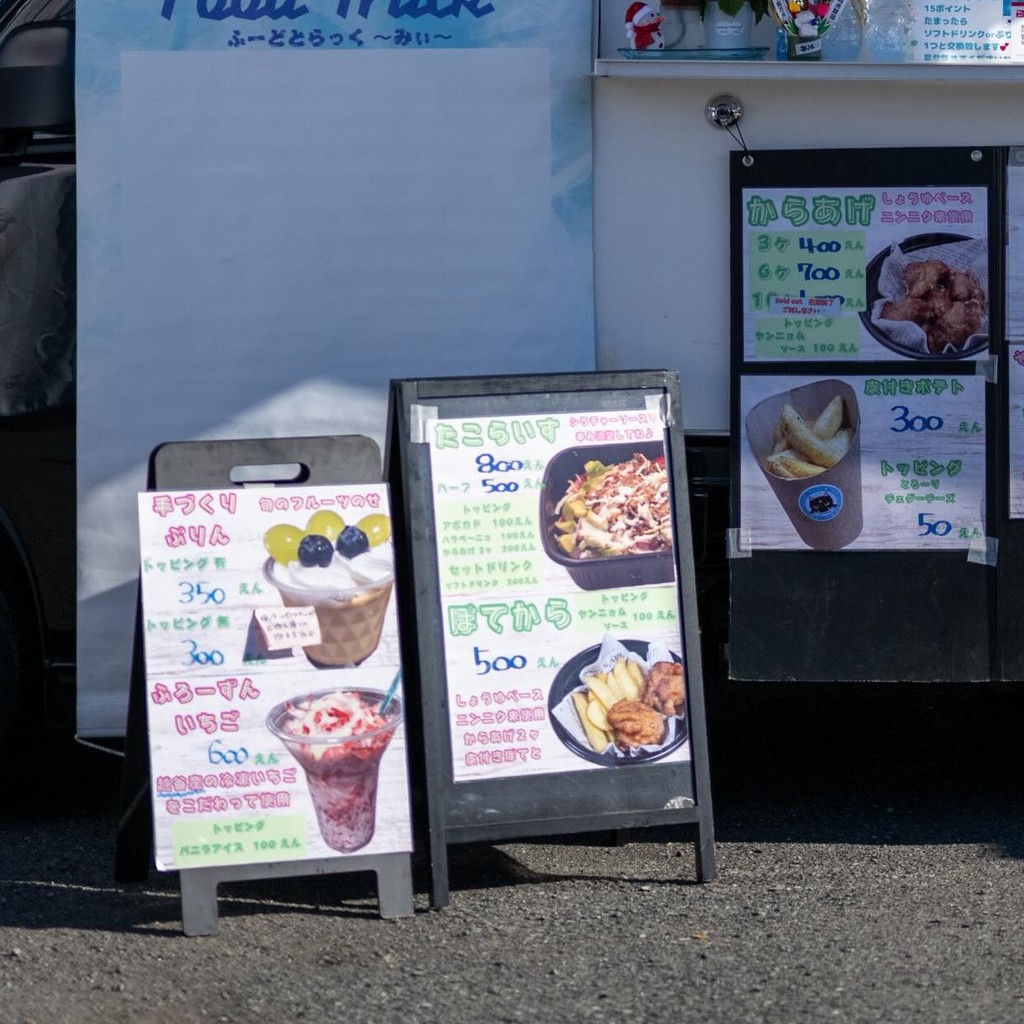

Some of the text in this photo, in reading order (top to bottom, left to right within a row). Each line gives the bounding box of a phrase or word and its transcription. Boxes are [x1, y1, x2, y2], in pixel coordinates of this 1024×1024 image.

[924, 4, 971, 13] 15ポイント
[924, 17, 968, 26] たまったら
[882, 192, 973, 205] しょうゆベース
[747, 194, 876, 226] からあげ
[881, 210, 973, 224] ニンニク未使用
[799, 237, 841, 253] 400
[798, 263, 840, 281] 700
[756, 331, 805, 341] ヤンニョム
[780, 344, 806, 353] ソース
[864, 379, 964, 396] 皮付きポテト
[890, 406, 982, 432] 300 えん
[434, 418, 560, 449] たこらいす
[475, 453, 524, 474] 800
[880, 460, 962, 477] トッピング
[438, 479, 519, 493] ハーフ 500
[153, 493, 237, 516] 手づくり
[259, 492, 380, 512] 旬のフルーツのせ
[443, 519, 481, 529] アボカド
[918, 513, 952, 536] 50
[165, 525, 230, 548] ぷりん
[449, 561, 532, 576] セットドリンク
[179, 582, 225, 604] 350
[445, 579, 498, 589] ソフトドリンク
[448, 598, 571, 636] ぽてから
[578, 609, 626, 621] ヤンニョム
[604, 621, 628, 630] ソース
[181, 640, 224, 666] 300
[474, 647, 559, 675] 500 えん
[152, 678, 260, 704] ふろーずん
[456, 688, 544, 708] しょうゆベース
[175, 710, 240, 735] いちご
[456, 708, 545, 726] ニンニク未使用
[208, 740, 279, 765] 600 えん
[465, 748, 541, 766] 皮付きぽてと
[166, 791, 290, 814] をこだわって使用
[180, 842, 244, 856] バニラアイス
